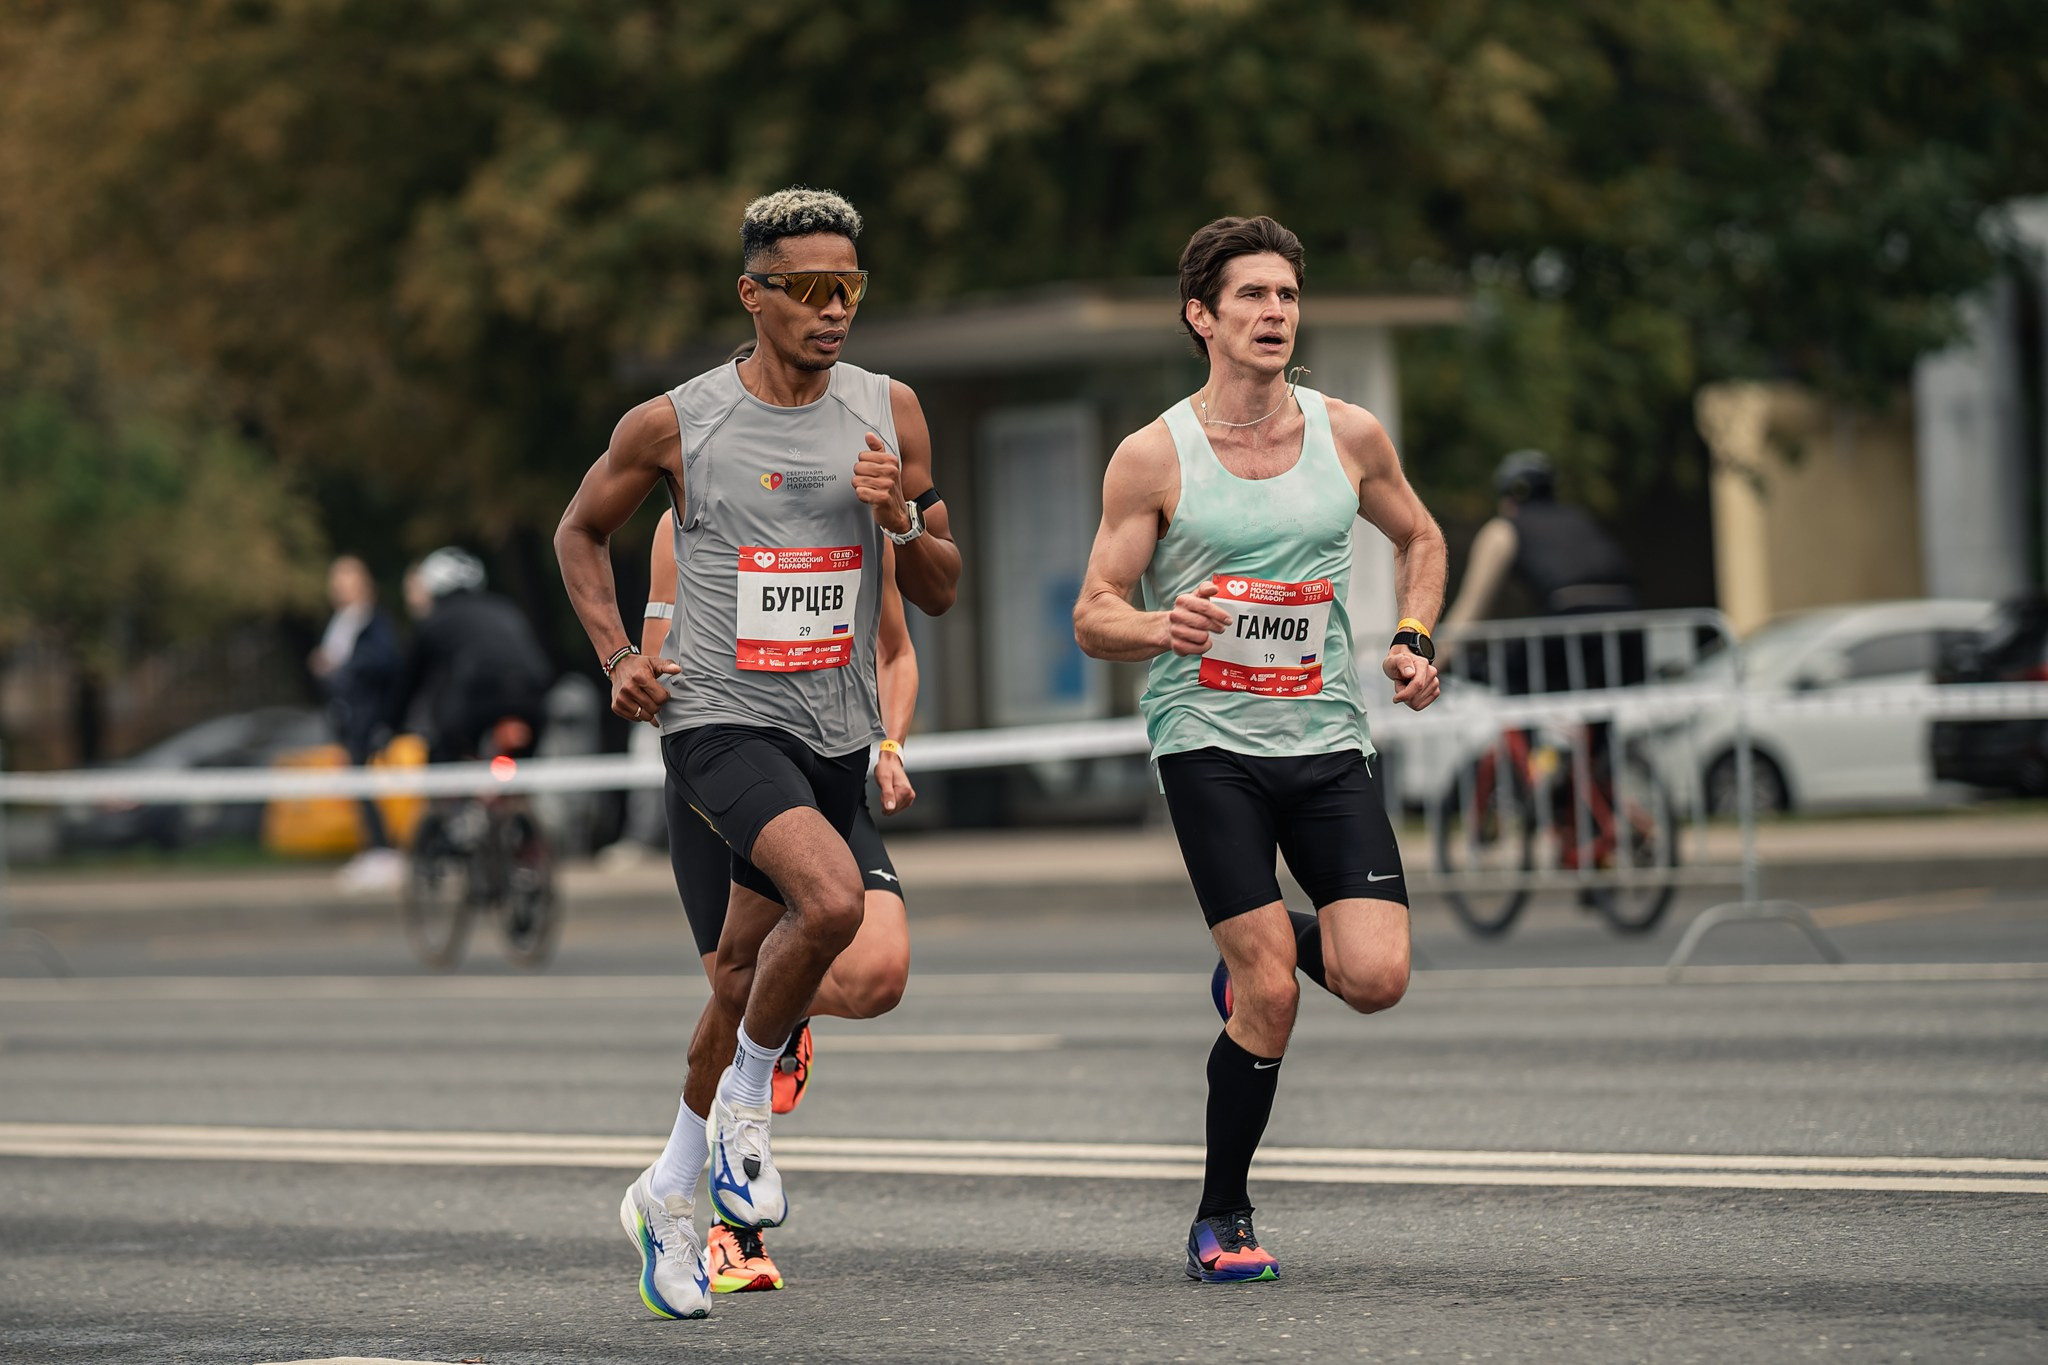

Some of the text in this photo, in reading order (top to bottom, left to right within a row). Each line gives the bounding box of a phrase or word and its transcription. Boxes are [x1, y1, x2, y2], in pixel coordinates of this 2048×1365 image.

[786, 475, 836, 483] МОСКОВСКИЙ
[1251, 582, 1286, 590] СБЕРПРАЙМ
[1250, 587, 1297, 597] МОСКОВСКИЙ
[762, 585, 844, 616] БУРЦЕВ
[1249, 593, 1285, 602] МАРАФОН
[799, 627, 811, 636] 29
[1236, 614, 1310, 641] ГАМОВ
[1264, 653, 1275, 663] 19
